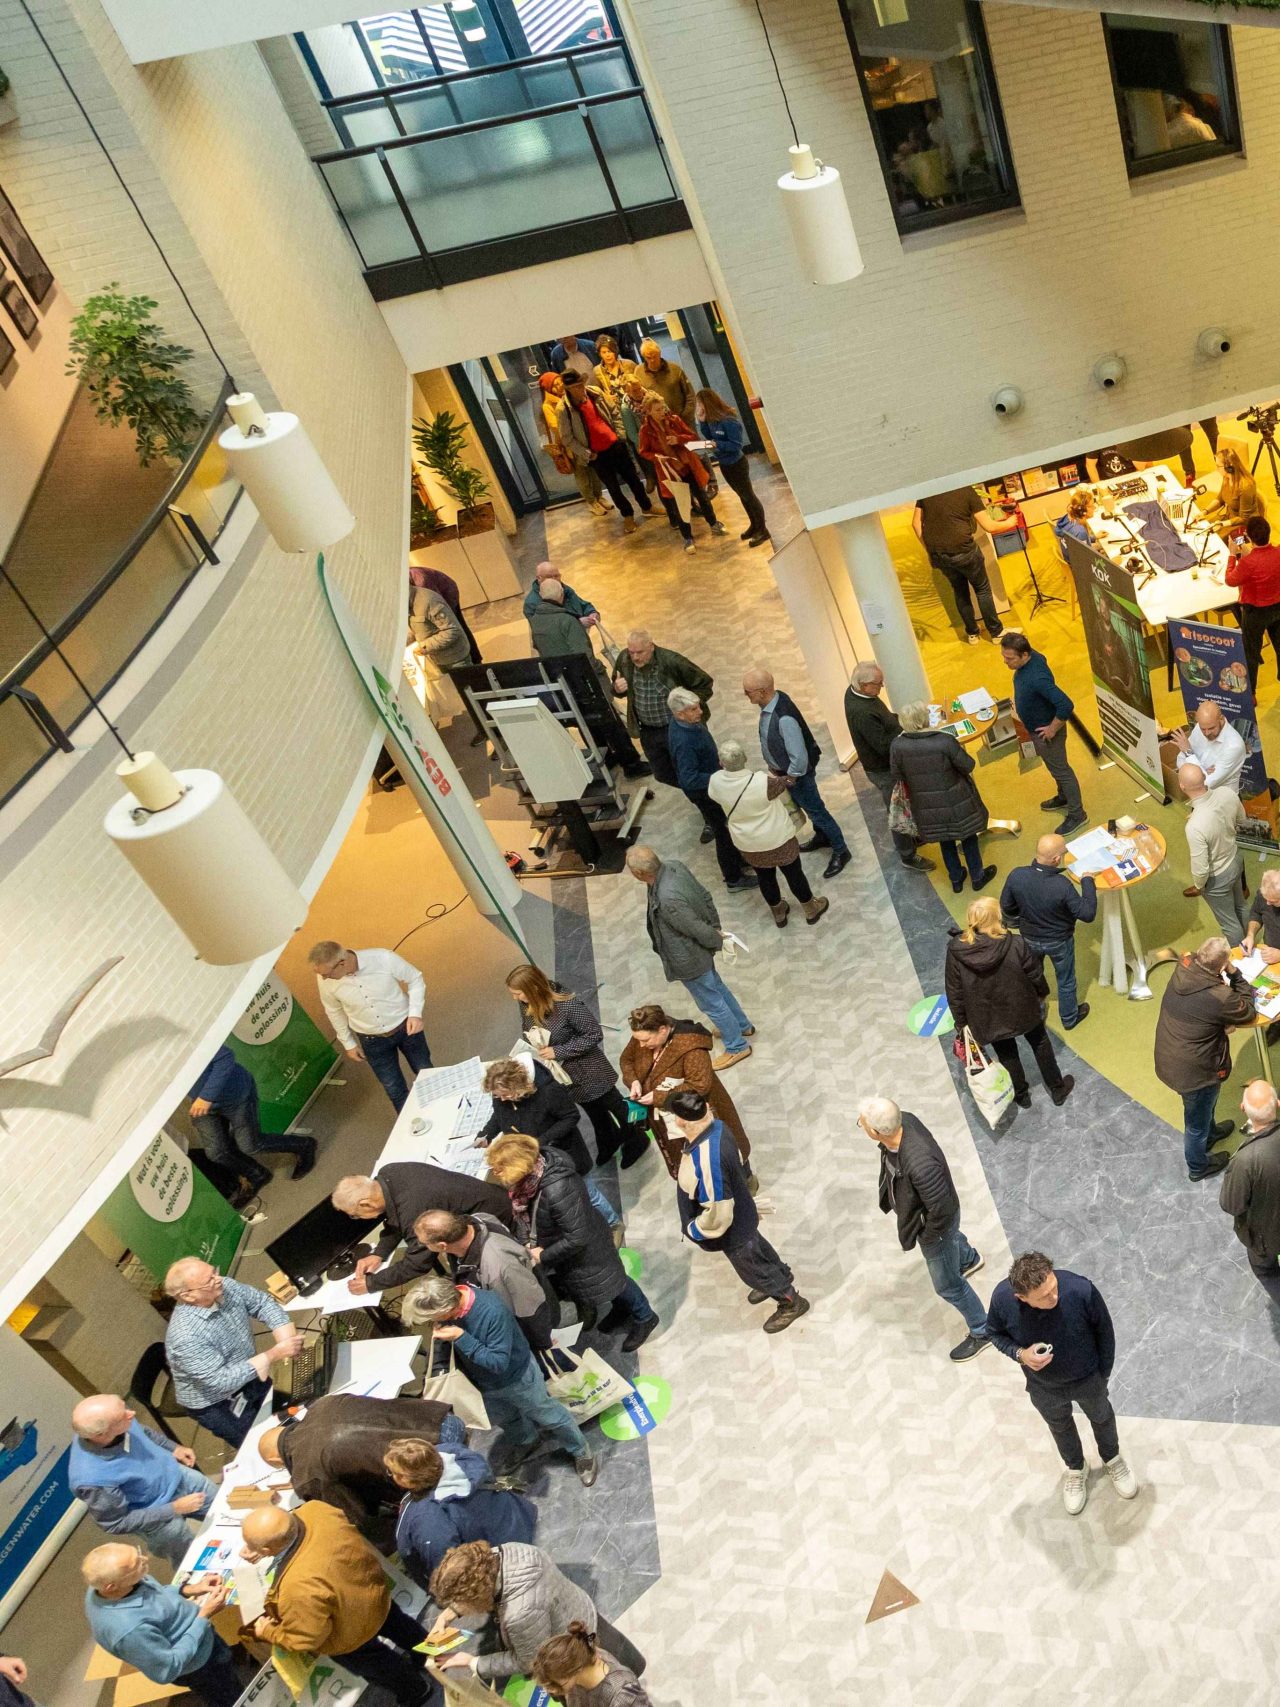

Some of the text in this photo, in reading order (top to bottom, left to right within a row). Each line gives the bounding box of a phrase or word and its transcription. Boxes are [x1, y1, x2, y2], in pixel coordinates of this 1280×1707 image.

[1192, 630, 1236, 648] Isocoat
[251, 991, 279, 1025] de beste
[255, 982, 272, 1002] huis
[254, 997, 289, 1040] oplossing?
[136, 1134, 164, 1185] Wat is voor
[150, 1153, 169, 1189] uw huis
[157, 1162, 179, 1200] de beste
[165, 1166, 191, 1216] oplossing?
[626, 1394, 648, 1427] Energieadvi
